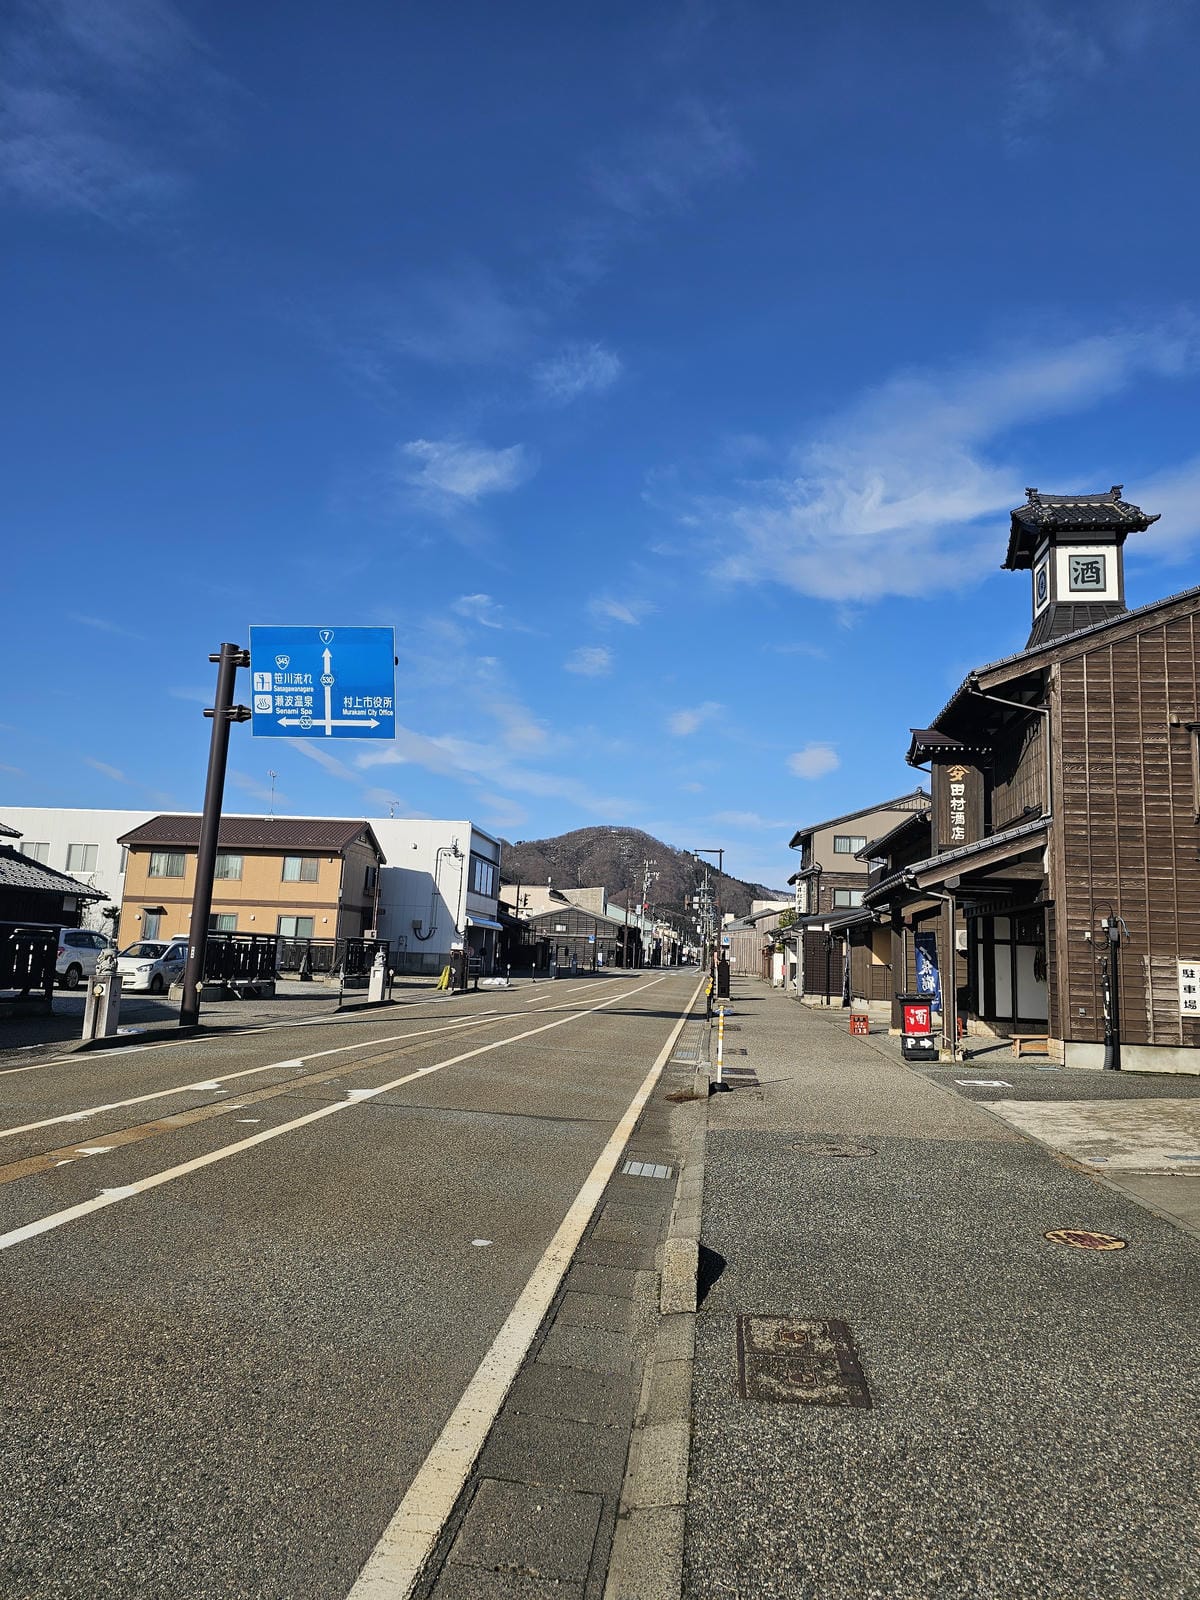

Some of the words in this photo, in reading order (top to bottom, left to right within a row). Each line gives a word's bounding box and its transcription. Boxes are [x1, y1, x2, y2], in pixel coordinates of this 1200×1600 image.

[1072, 560, 1101, 585] 酒
[323, 631, 330, 640] 7
[274, 672, 313, 685] 笹川流れ
[274, 695, 313, 707] 瀬波温泉
[343, 696, 393, 708] 村上市役所
[300, 708, 313, 716] Spa
[342, 708, 367, 716] Murakami
[367, 708, 378, 717] City
[378, 708, 394, 716] Office
[950, 783, 967, 841] 田村酒店
[1182, 968, 1198, 1010] 駐車場
[906, 1008, 928, 1026] 酒
[906, 1038, 916, 1049] P
